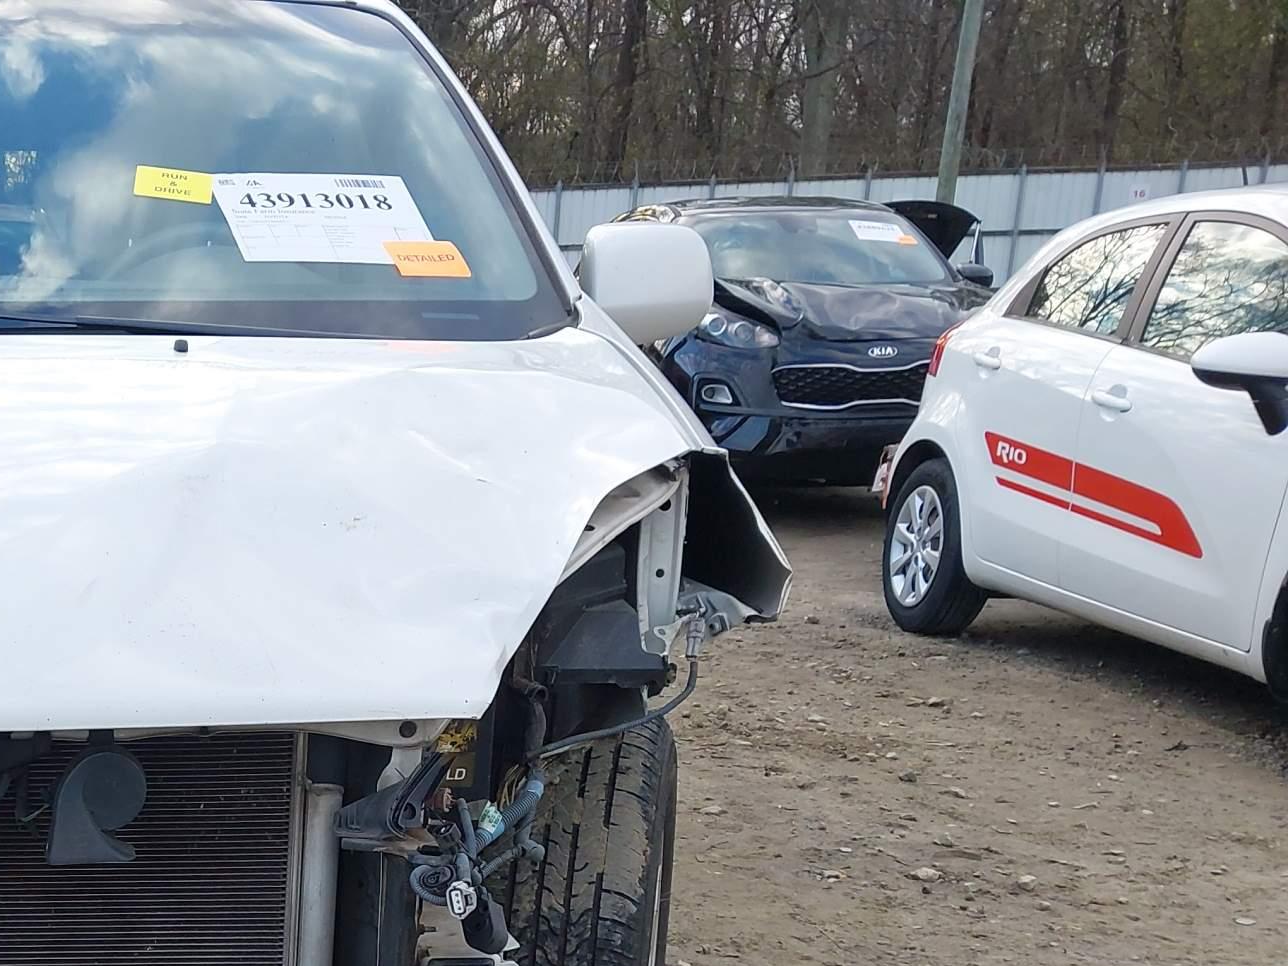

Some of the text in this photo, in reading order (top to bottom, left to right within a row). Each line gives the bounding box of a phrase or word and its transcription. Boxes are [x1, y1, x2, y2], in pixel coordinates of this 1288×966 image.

[161, 172, 188, 181] RUN
[154, 186, 192, 196] DRIVE
[239, 192, 393, 210] 43913018
[396, 253, 455, 262] DETAILED
[872, 346, 895, 357] KIA
